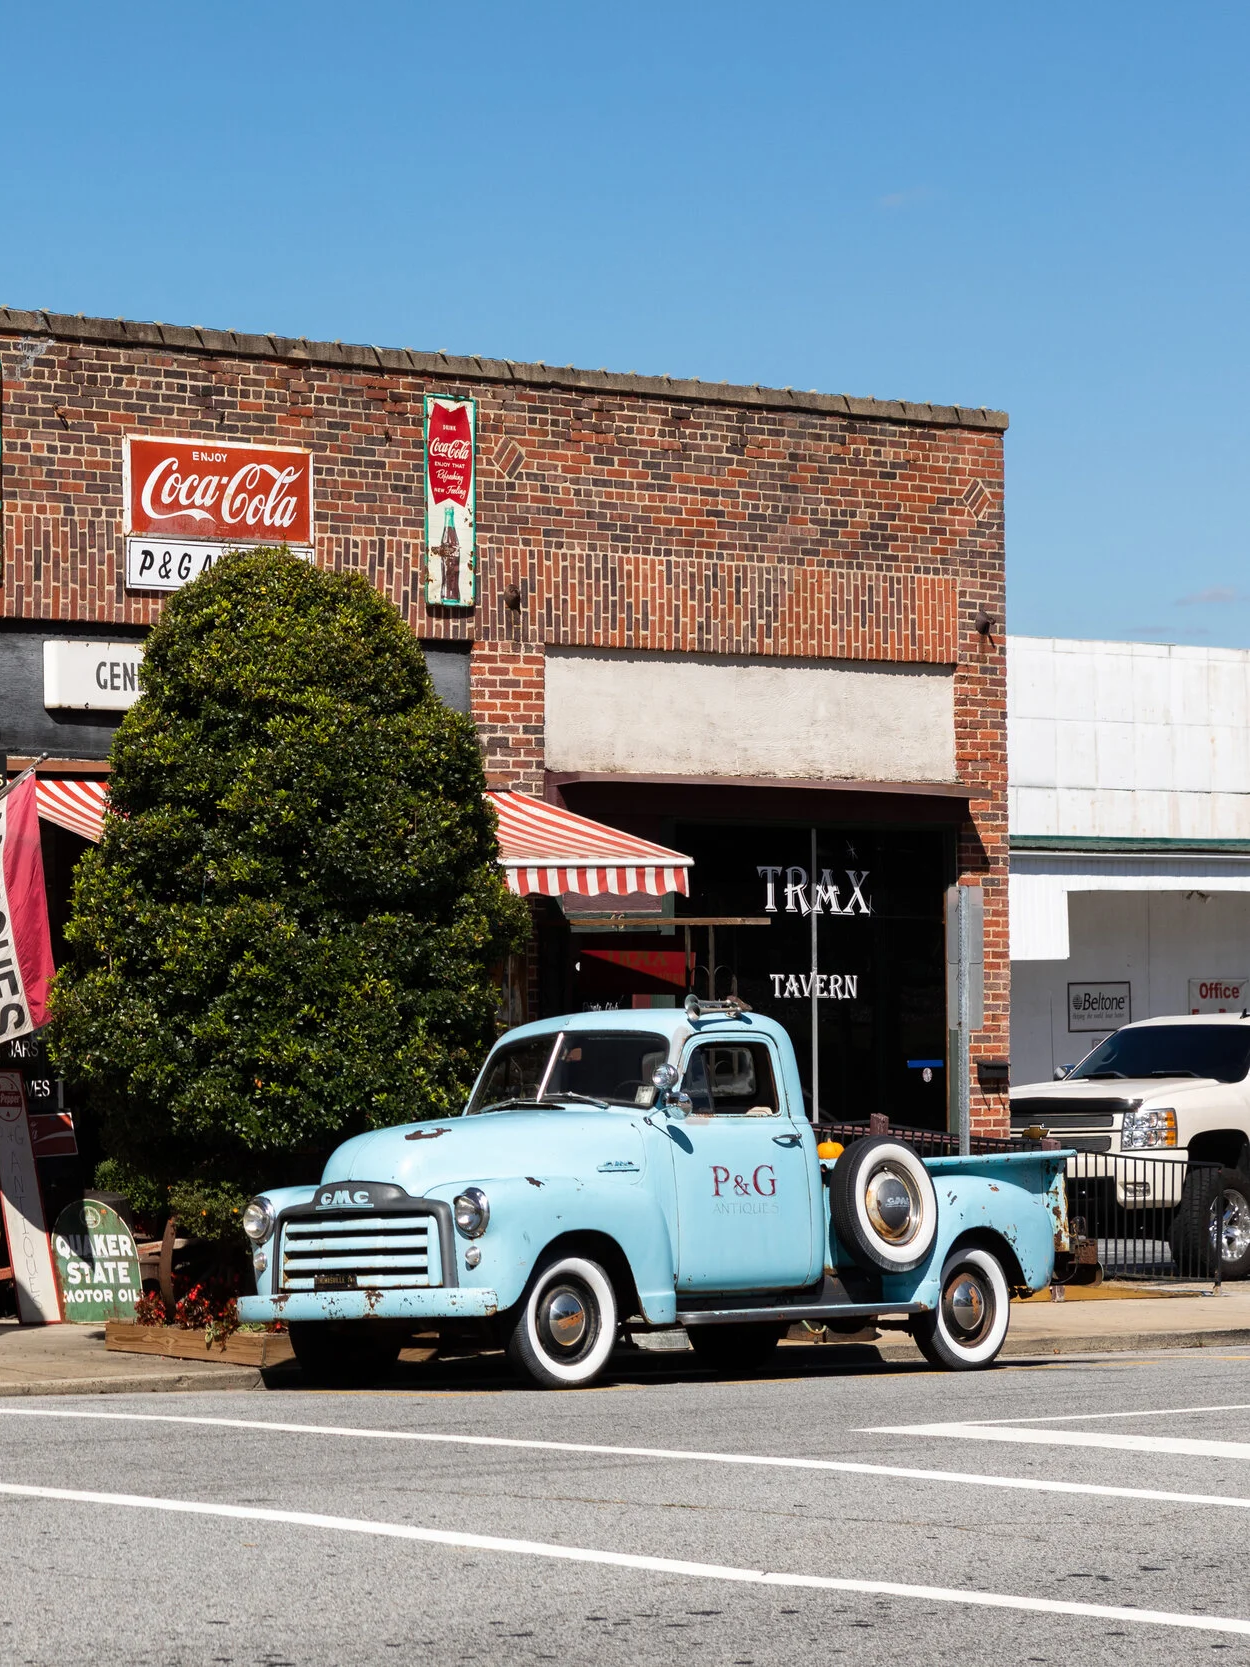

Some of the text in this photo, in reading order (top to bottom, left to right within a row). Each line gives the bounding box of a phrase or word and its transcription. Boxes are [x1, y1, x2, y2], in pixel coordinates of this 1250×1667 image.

[442, 424, 457, 432] DRINK
[192, 451, 228, 463] ENJOY
[429, 436, 471, 460] Coca-Cola
[141, 457, 305, 528] Coca-Cola
[445, 485, 467, 500] Feeling
[756, 866, 871, 917] TRAX
[769, 972, 858, 1000] TAVERN
[1199, 982, 1240, 1000] Office
[1082, 992, 1125, 1011] Beltone
[8, 1040, 39, 1058] JARS
[709, 1164, 779, 1198] P&G
[320, 1190, 370, 1205] GMC
[713, 1202, 780, 1215] ANTIQUES
[55, 1234, 134, 1259] QUAKER
[66, 1261, 131, 1285] STATE
[63, 1288, 141, 1303] MOTOR OIL
